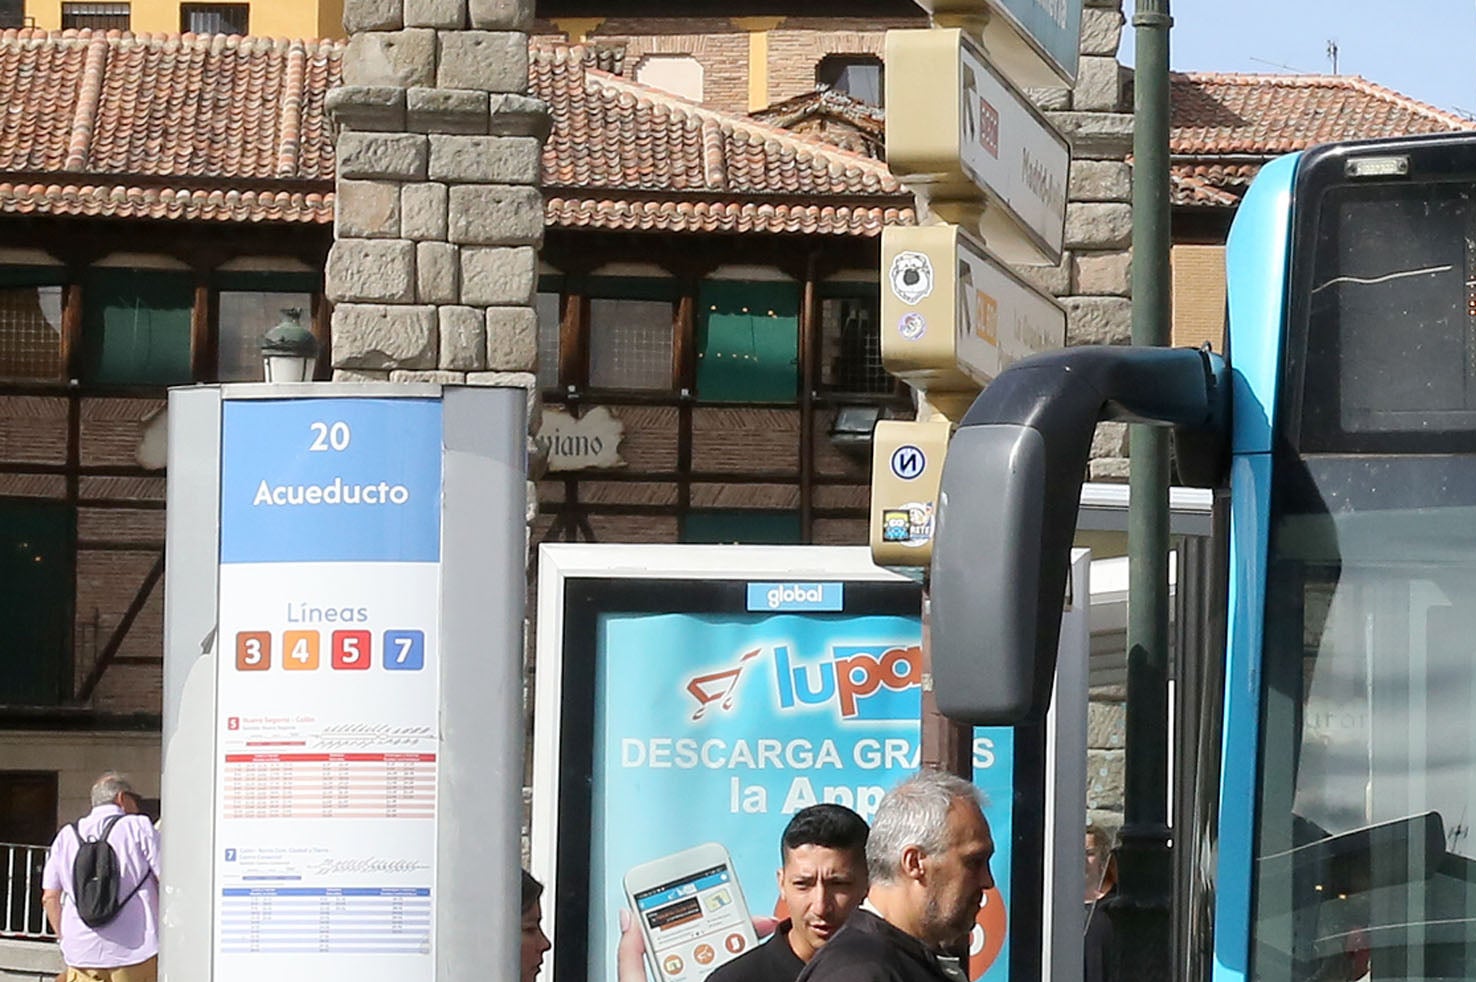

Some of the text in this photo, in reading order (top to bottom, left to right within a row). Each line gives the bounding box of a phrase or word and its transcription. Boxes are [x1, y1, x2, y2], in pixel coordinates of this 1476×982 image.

[310, 421, 351, 452] 20
[252, 477, 410, 506] Acueducto
[767, 584, 824, 609] global
[286, 602, 369, 624] Líneas
[244, 637, 413, 665] 3 4 5 7
[621, 737, 996, 770] DESCARGA GRS
[730, 776, 768, 814] la
